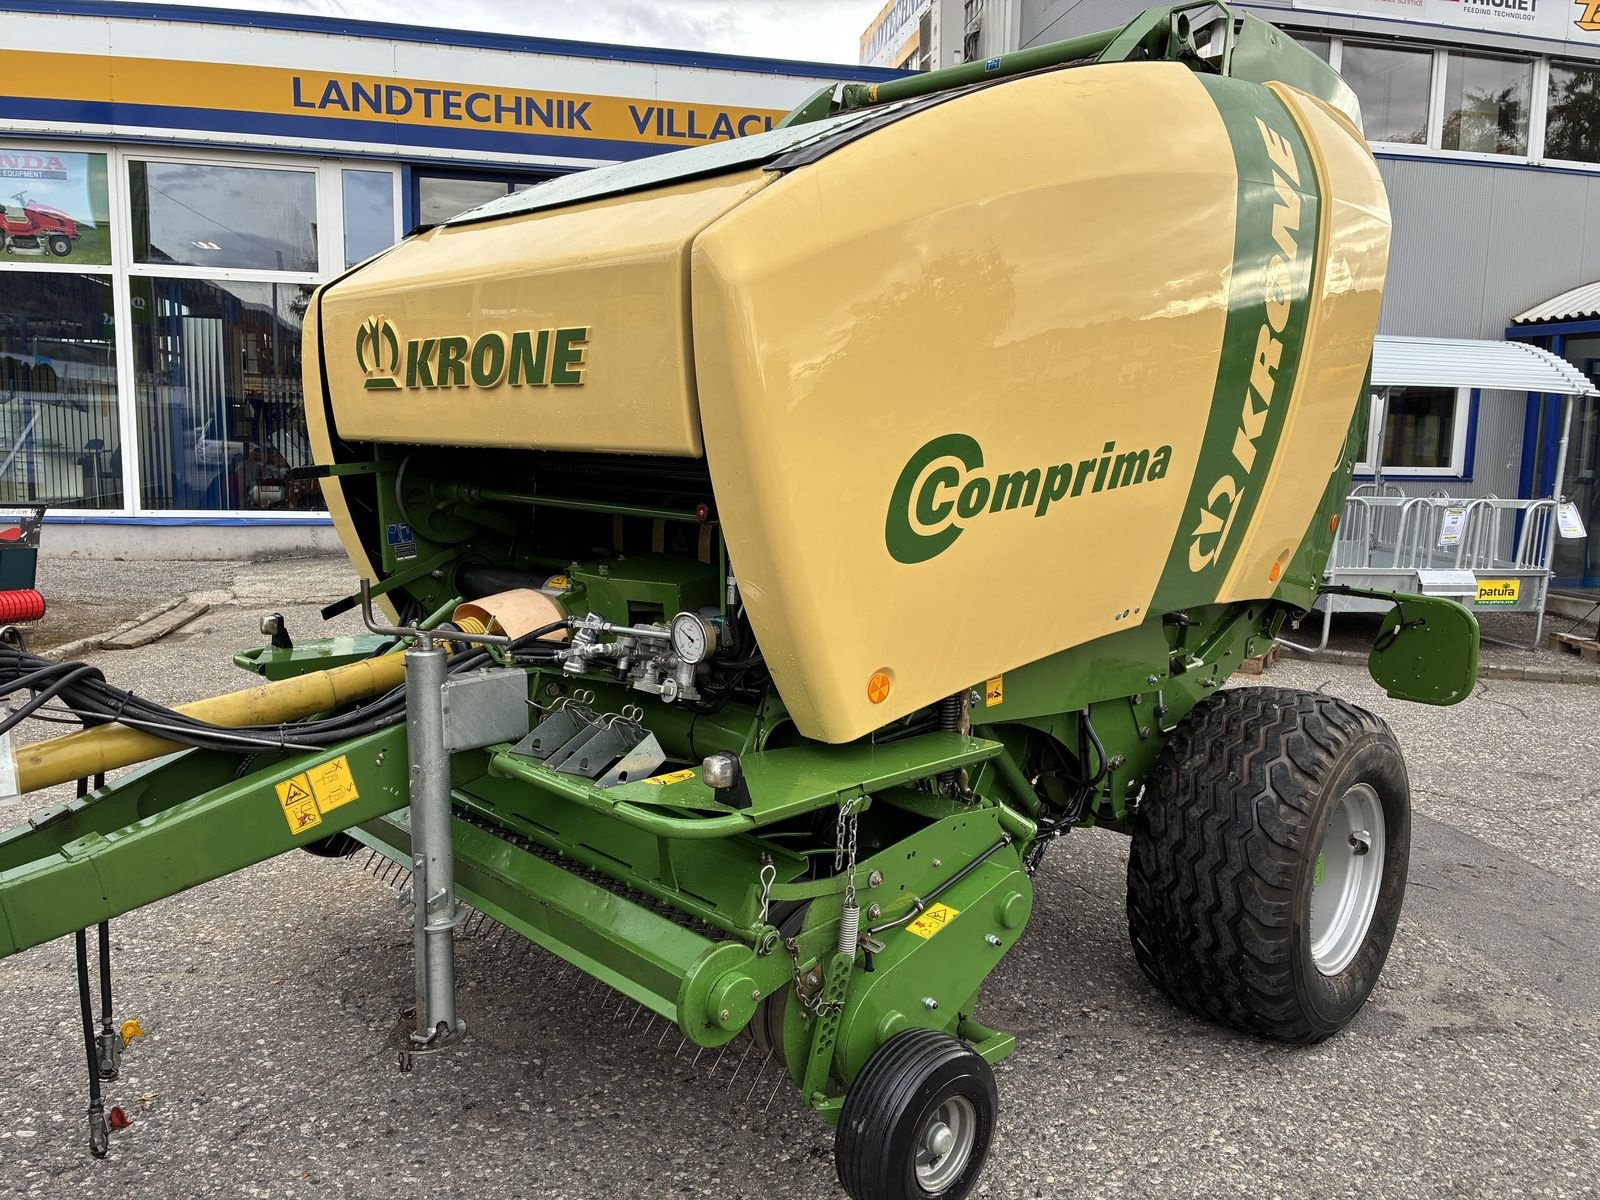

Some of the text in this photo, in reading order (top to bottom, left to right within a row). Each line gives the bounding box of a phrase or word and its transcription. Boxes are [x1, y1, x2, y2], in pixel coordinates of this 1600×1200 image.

[1463, 6, 1536, 21] FEEDING TECHNOLOGY
[292, 76, 592, 131] LANDTECHNIK
[3, 170, 43, 178] EQUIPMENT
[1232, 115, 1303, 474] KRONE
[405, 326, 591, 388] KRONE
[885, 433, 1173, 565] Comprima
[1479, 585, 1515, 599] patura
